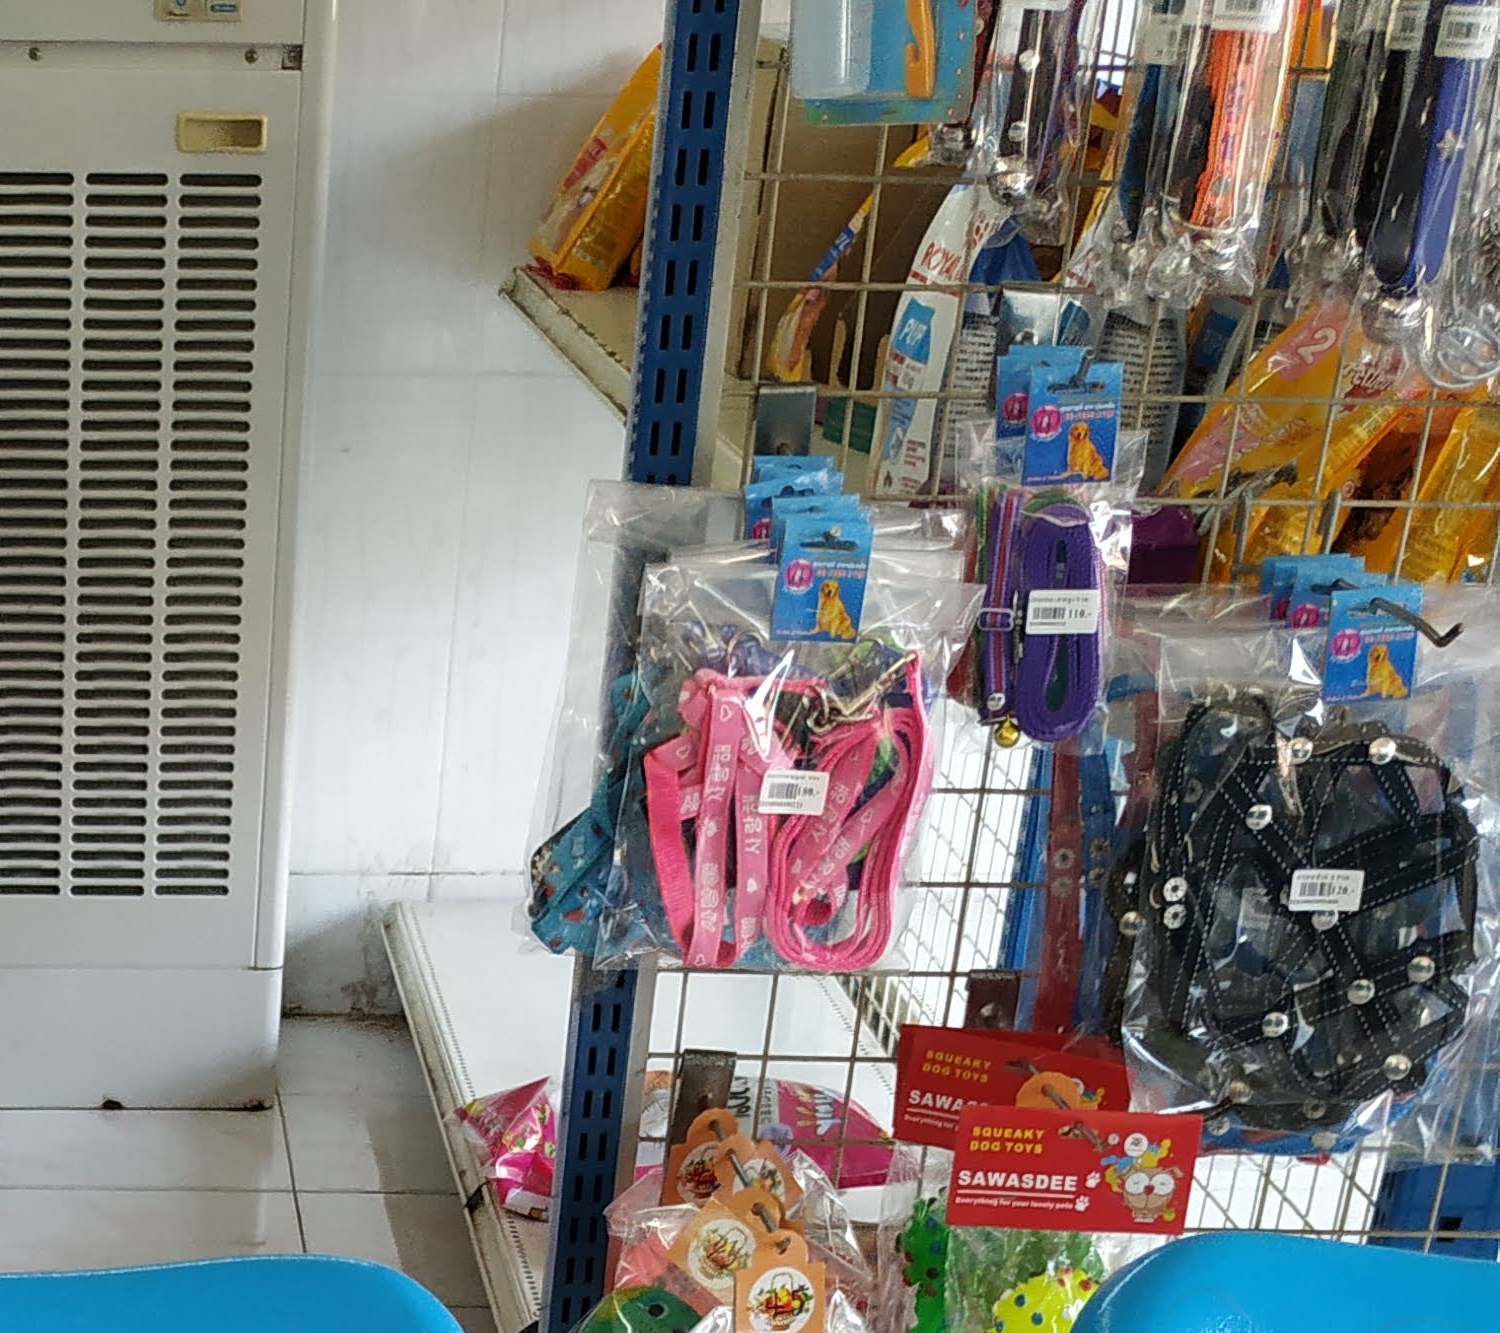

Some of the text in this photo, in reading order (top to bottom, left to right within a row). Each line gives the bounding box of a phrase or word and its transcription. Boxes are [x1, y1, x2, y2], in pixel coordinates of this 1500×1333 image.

[1297, 326, 1337, 364] 2
[926, 1050, 991, 1070] SQUEAKY
[922, 1063, 988, 1083] DOG TOYS
[972, 1126, 1045, 1140] SQUEAKY
[969, 1140, 1043, 1155] DOG TOYS
[957, 1170, 1078, 1192] SAWASDEE
[955, 1195, 998, 1207] Everything
[999, 1198, 1011, 1206] for
